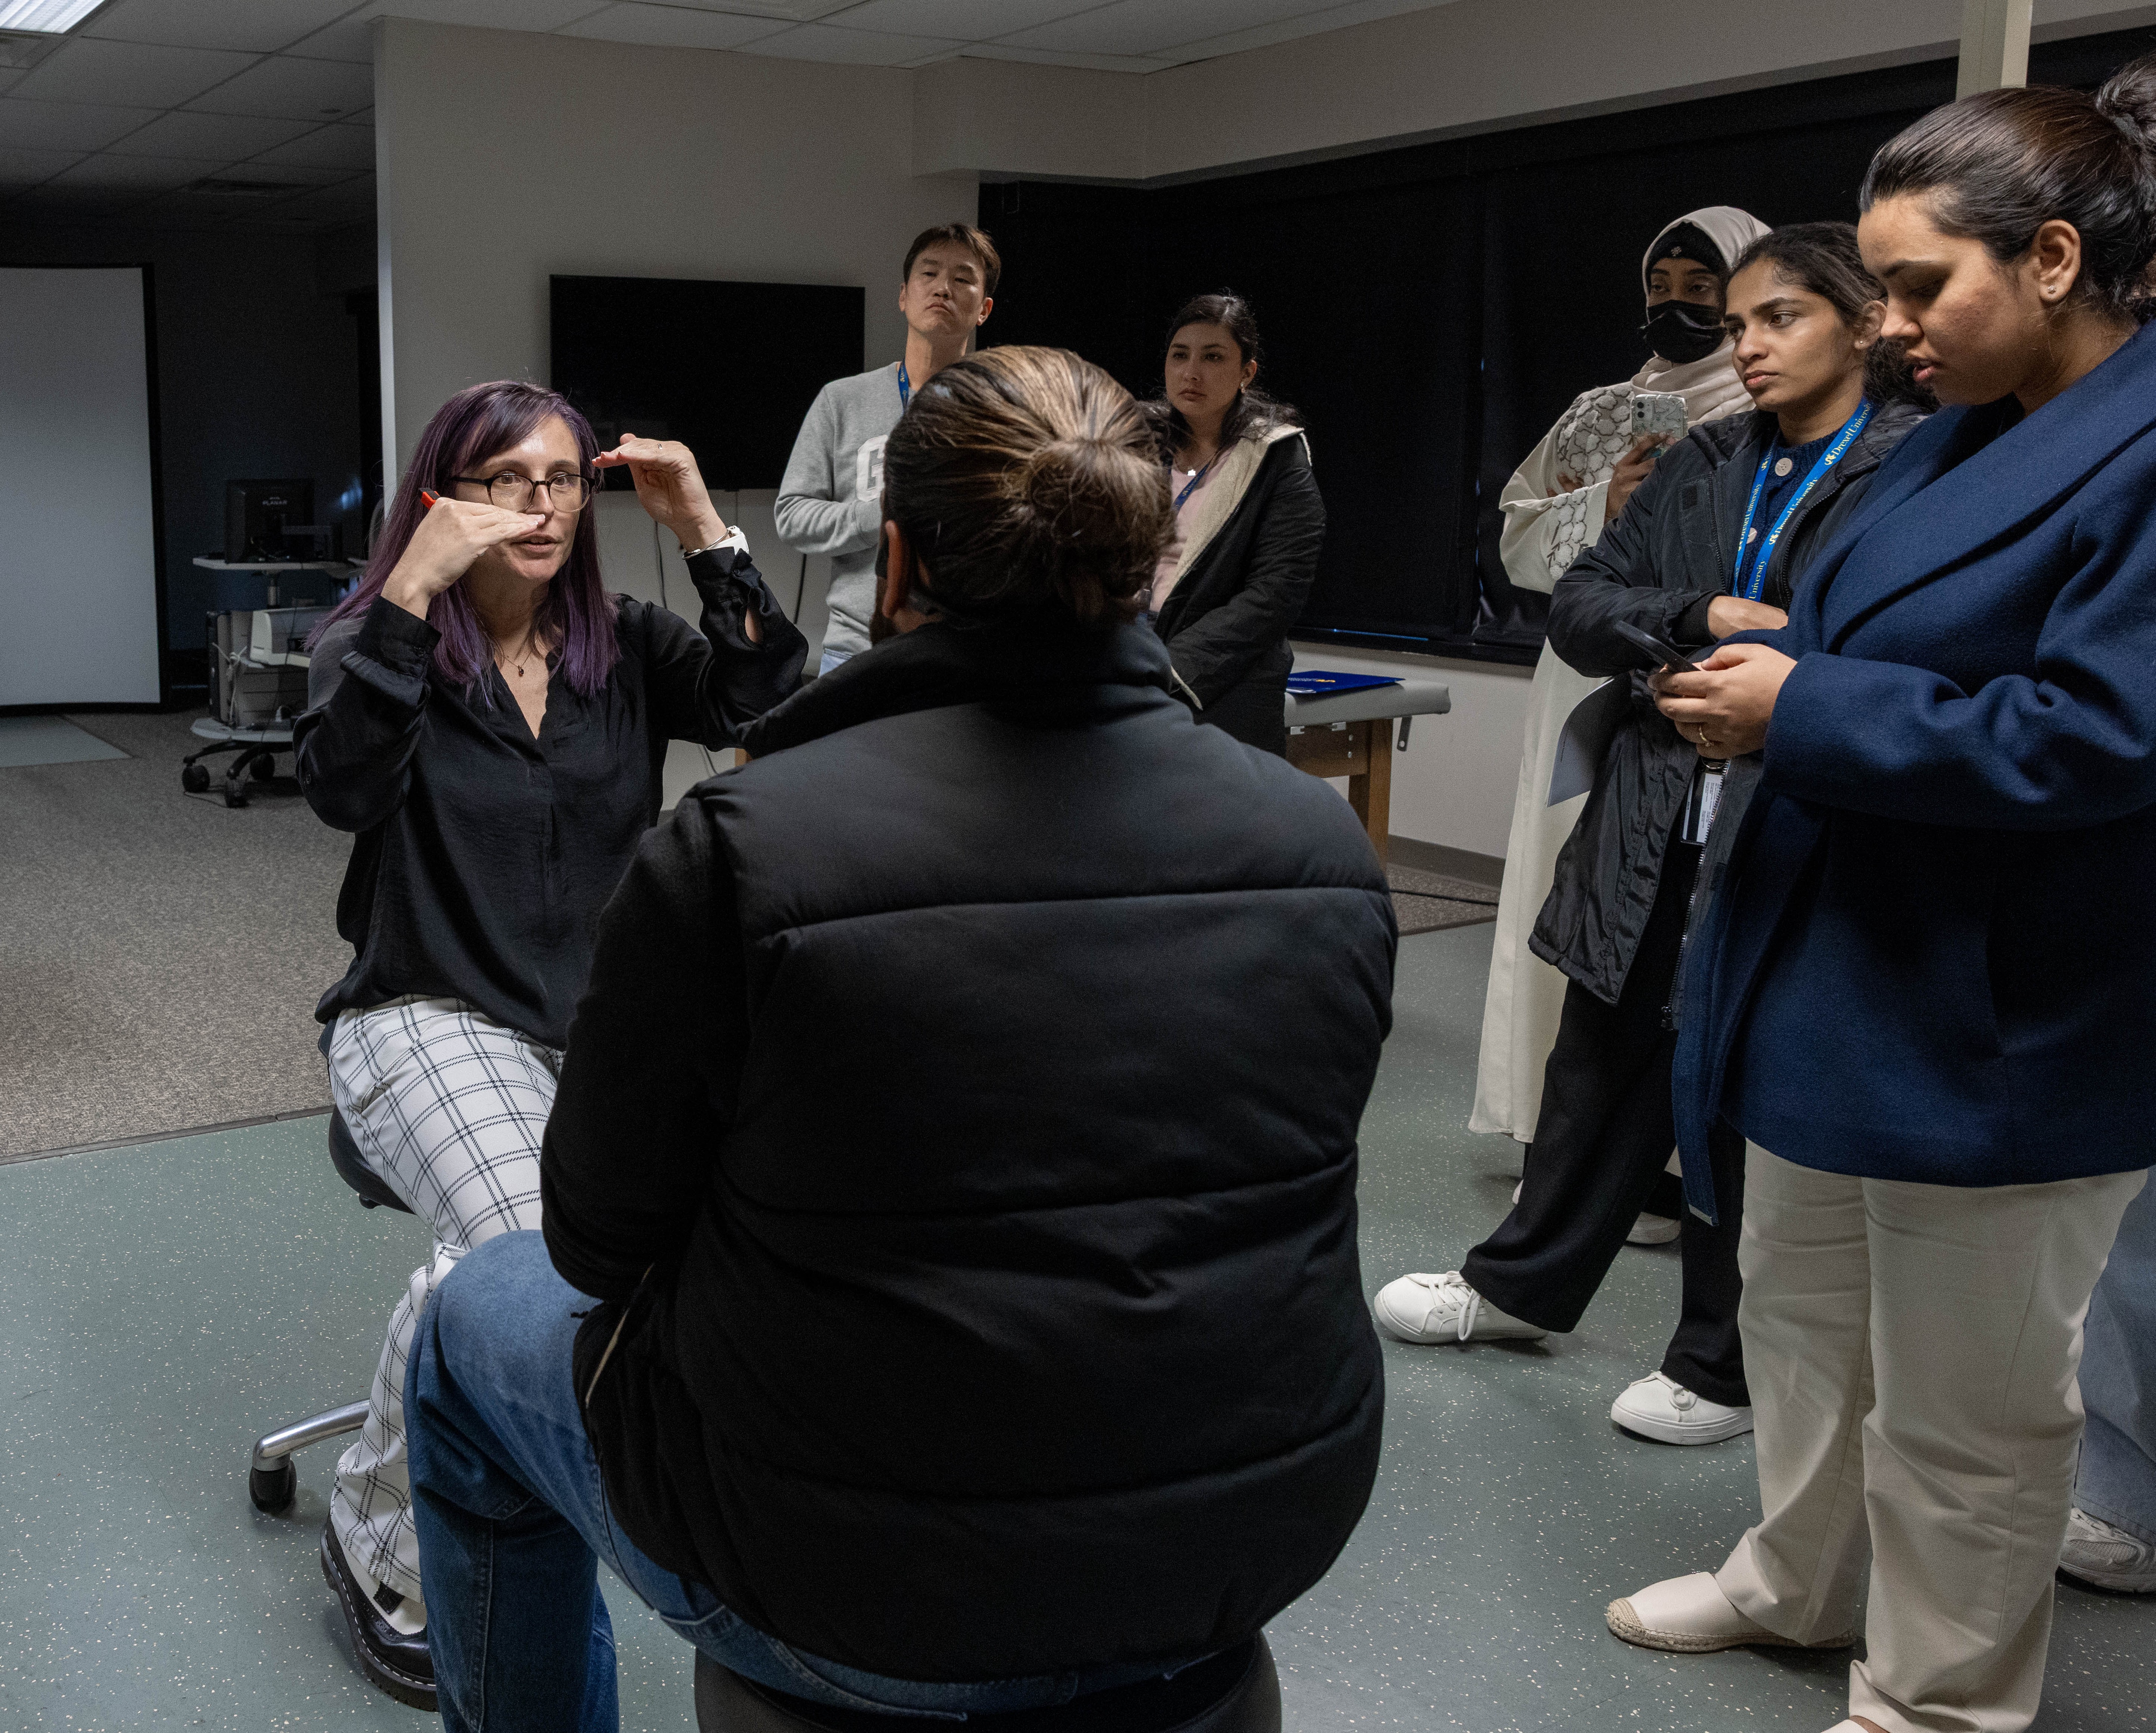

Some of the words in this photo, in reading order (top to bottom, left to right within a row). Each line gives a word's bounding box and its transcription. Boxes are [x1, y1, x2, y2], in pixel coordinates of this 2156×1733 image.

[1831, 431, 1854, 456] Drexel
[1848, 402, 1872, 433] Universit
[1745, 484, 1761, 517] University
[1749, 560, 1767, 599] University
